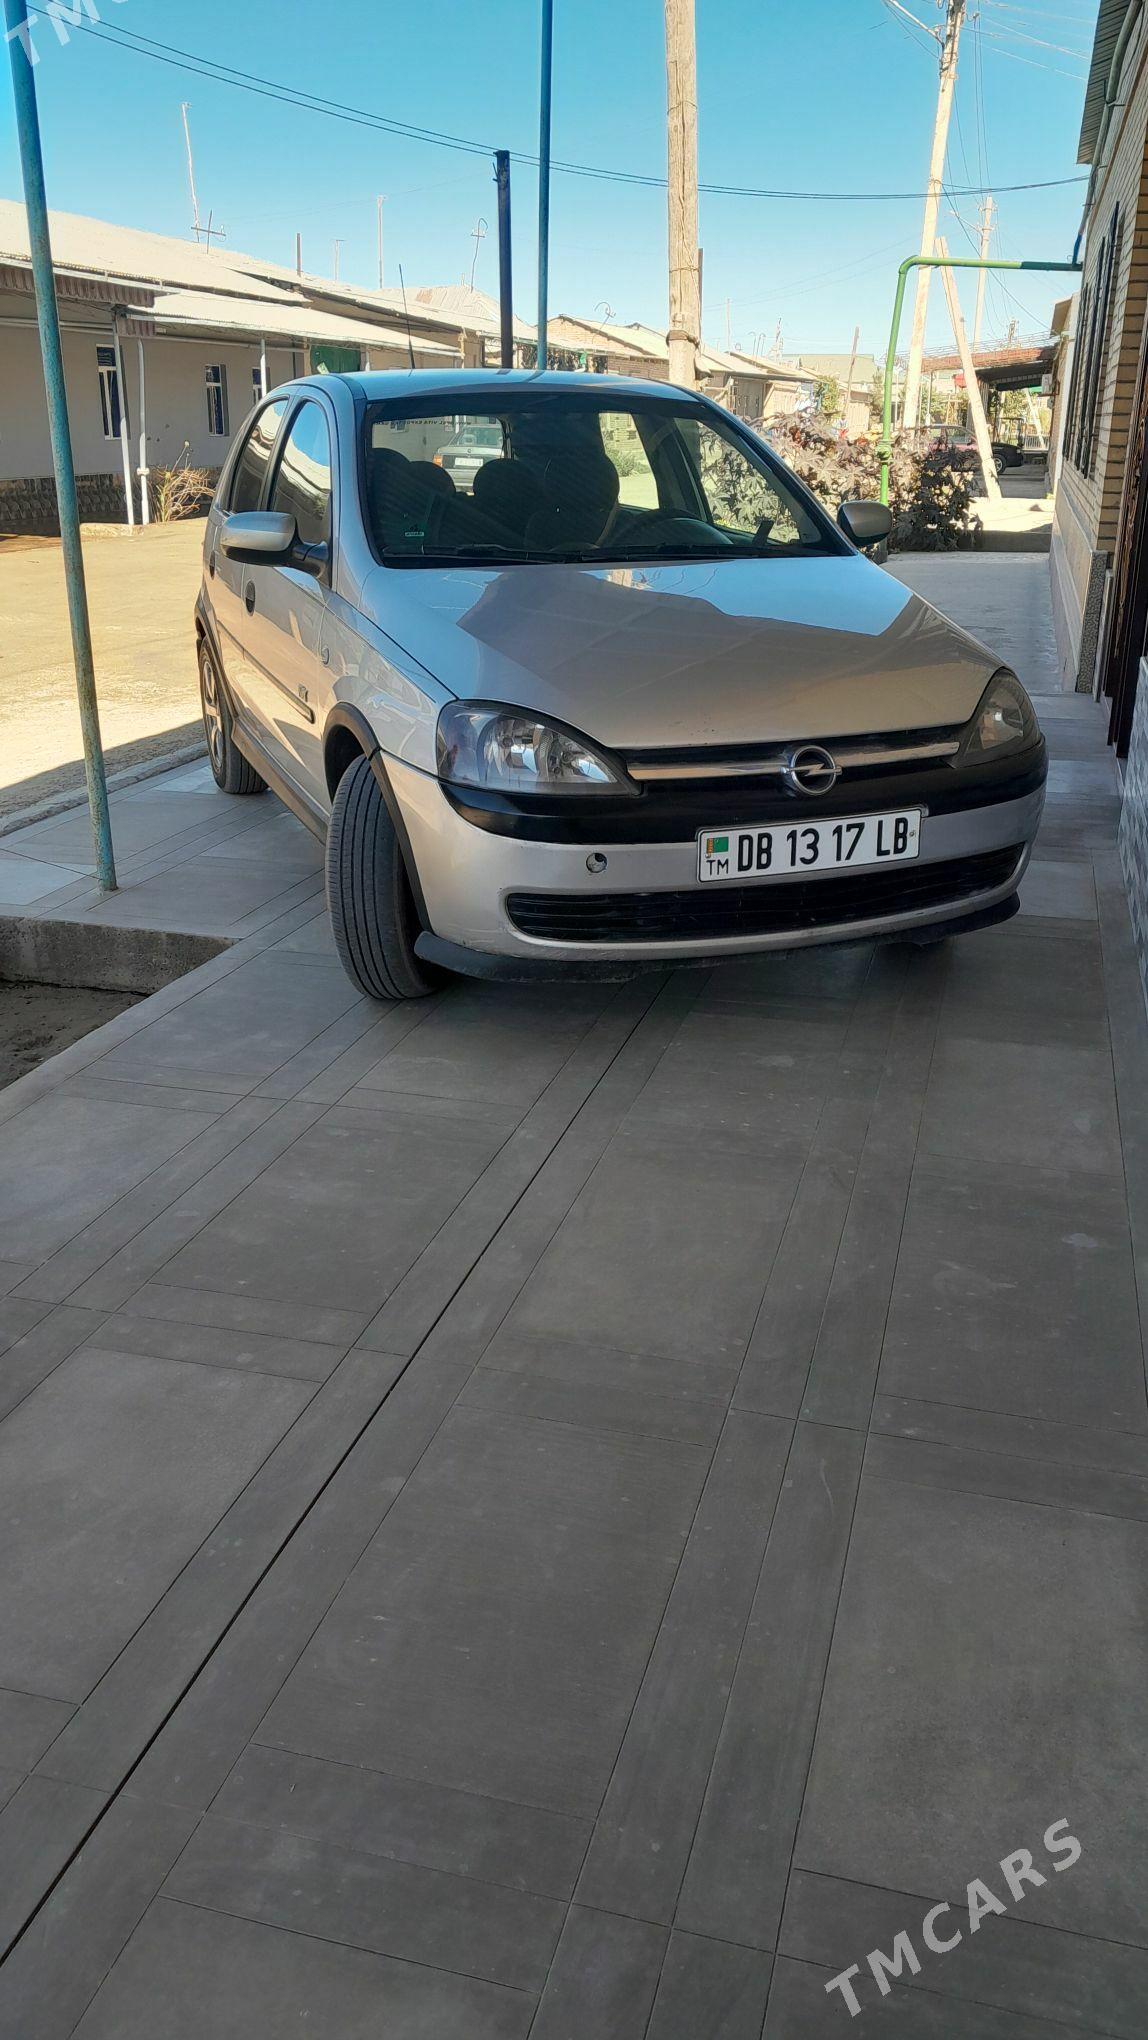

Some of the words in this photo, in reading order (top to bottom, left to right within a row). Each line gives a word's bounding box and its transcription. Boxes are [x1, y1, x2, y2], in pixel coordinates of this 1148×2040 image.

[738, 832, 773, 872] DB
[786, 828, 820, 867] 13
[832, 822, 865, 862] 17
[876, 817, 909, 857] LB
[706, 858, 729, 876] TM
